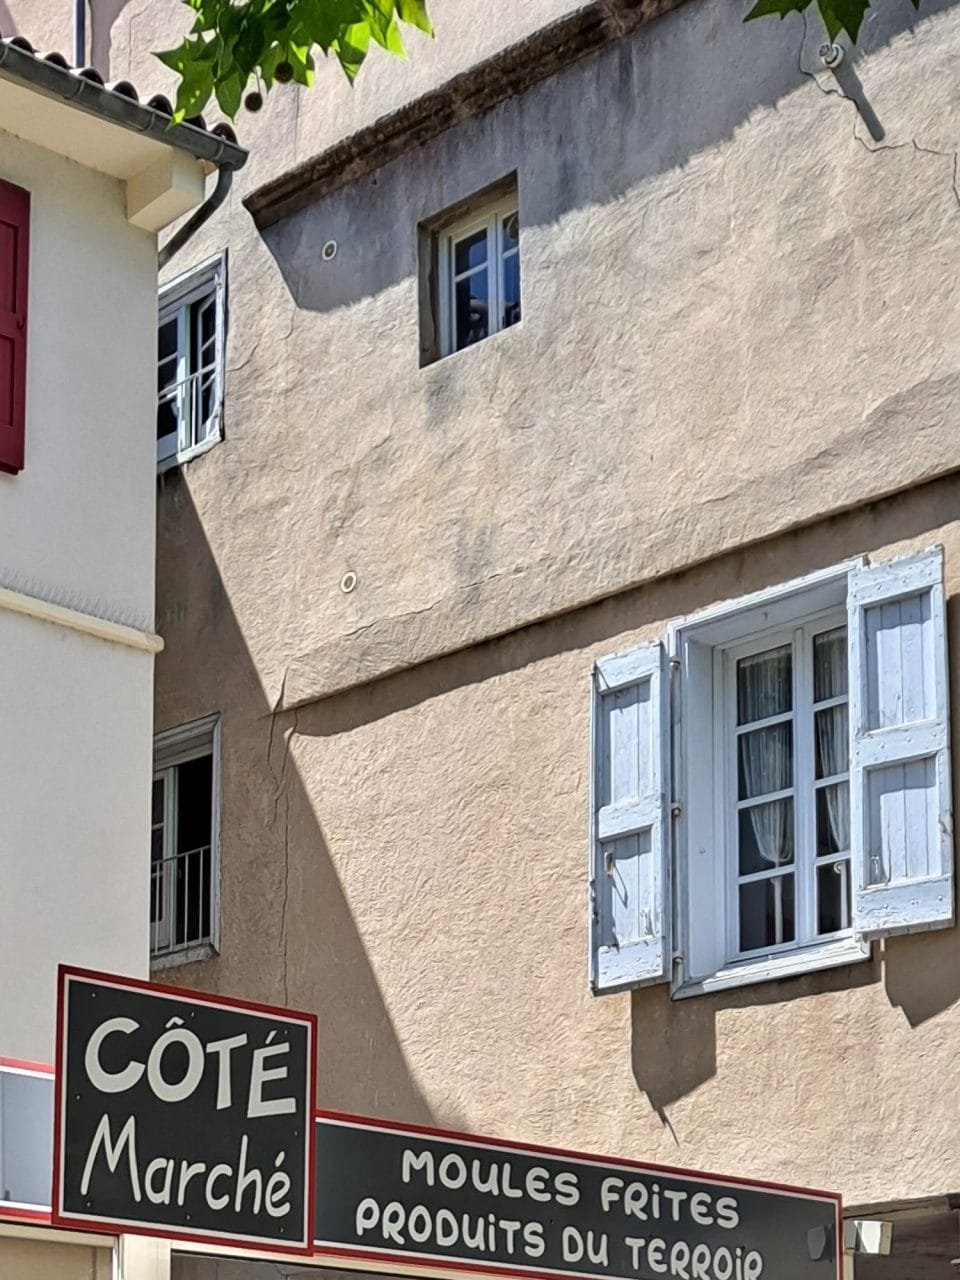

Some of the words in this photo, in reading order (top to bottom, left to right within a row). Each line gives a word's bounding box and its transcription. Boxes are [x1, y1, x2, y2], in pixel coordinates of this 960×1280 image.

[85, 1016, 297, 1118] CÔTÉ
[80, 1113, 292, 1217] Marché
[402, 1149, 580, 1206] MOULES
[601, 1177, 739, 1229] FRITES
[356, 1197, 545, 1258] PRODUITS
[562, 1226, 609, 1267] DU
